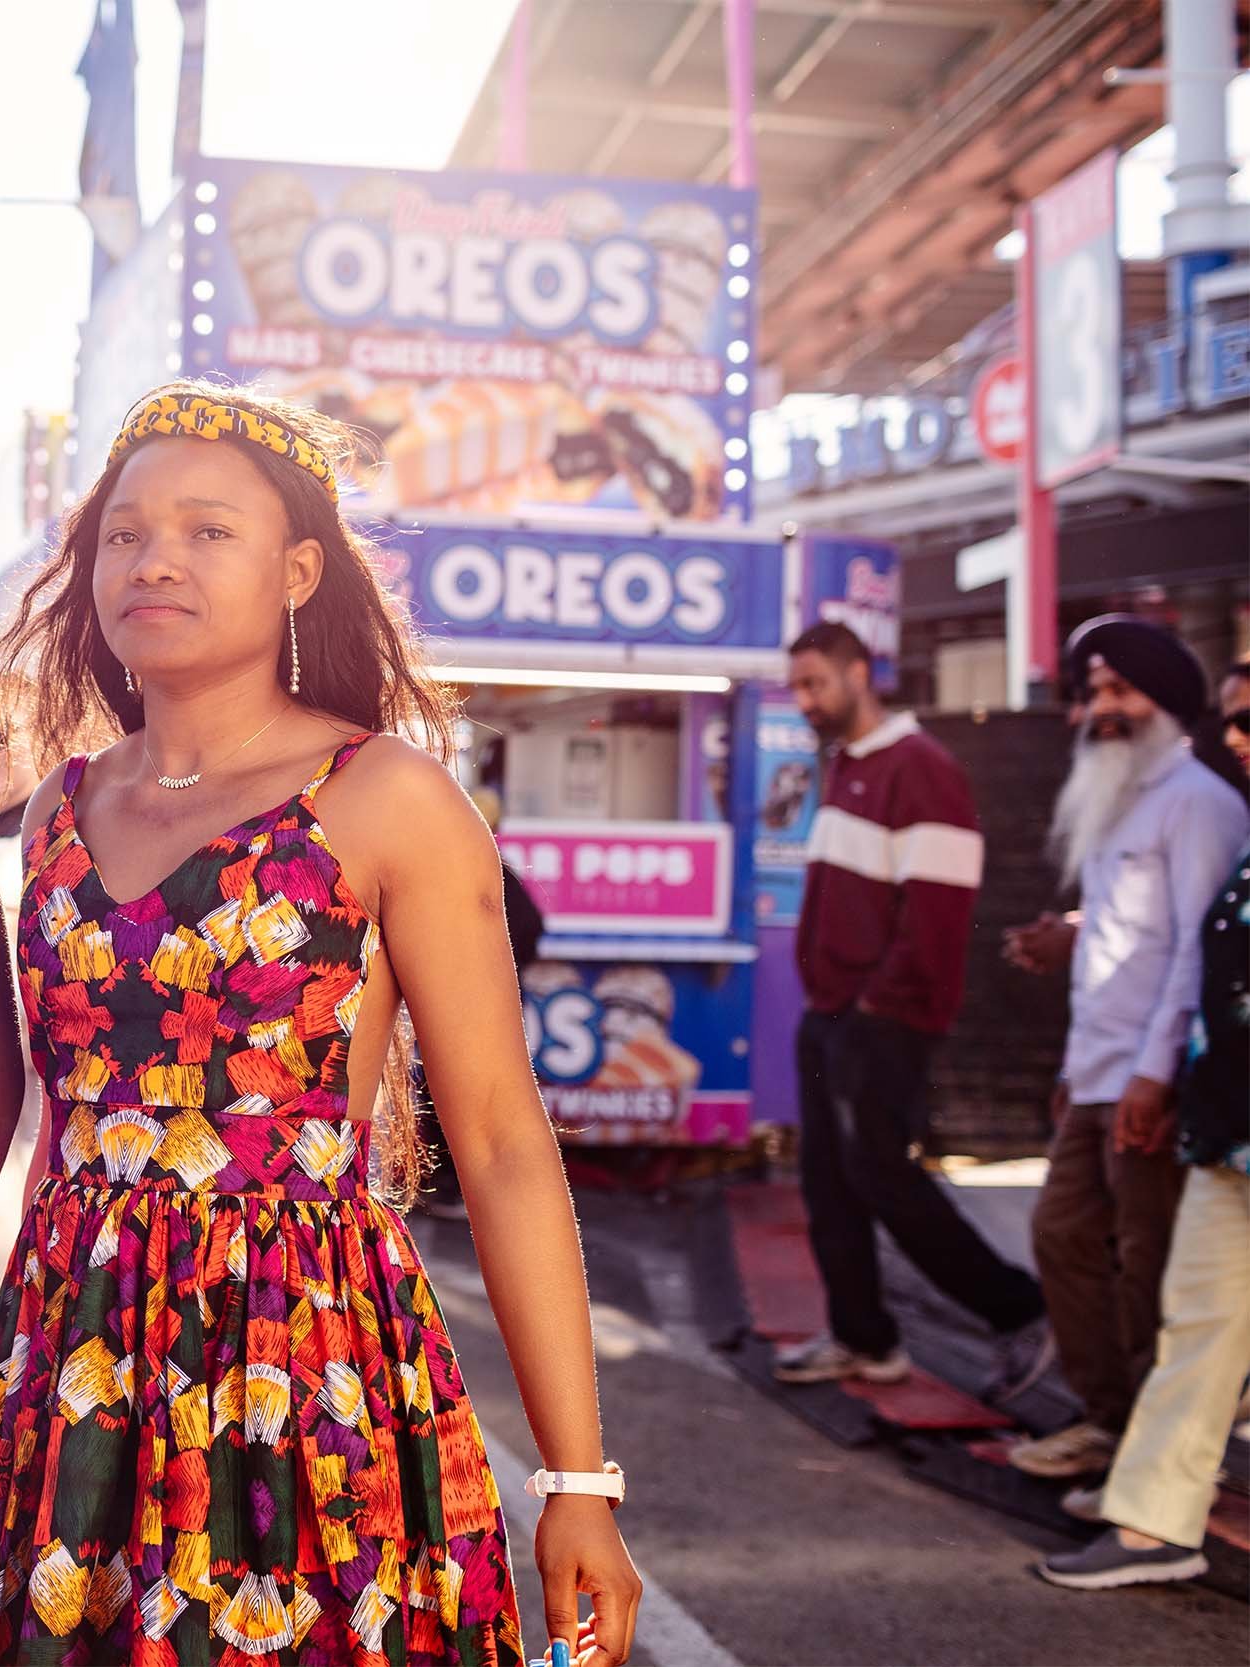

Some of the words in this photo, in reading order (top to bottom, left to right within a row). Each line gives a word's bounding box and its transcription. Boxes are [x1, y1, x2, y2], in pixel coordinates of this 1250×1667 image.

[305, 222, 652, 337] OREOS
[351, 338, 547, 379] CHEESECAKE
[577, 352, 719, 392] TWINKIES
[431, 544, 726, 634] OREOS
[573, 844, 693, 886] POPS
